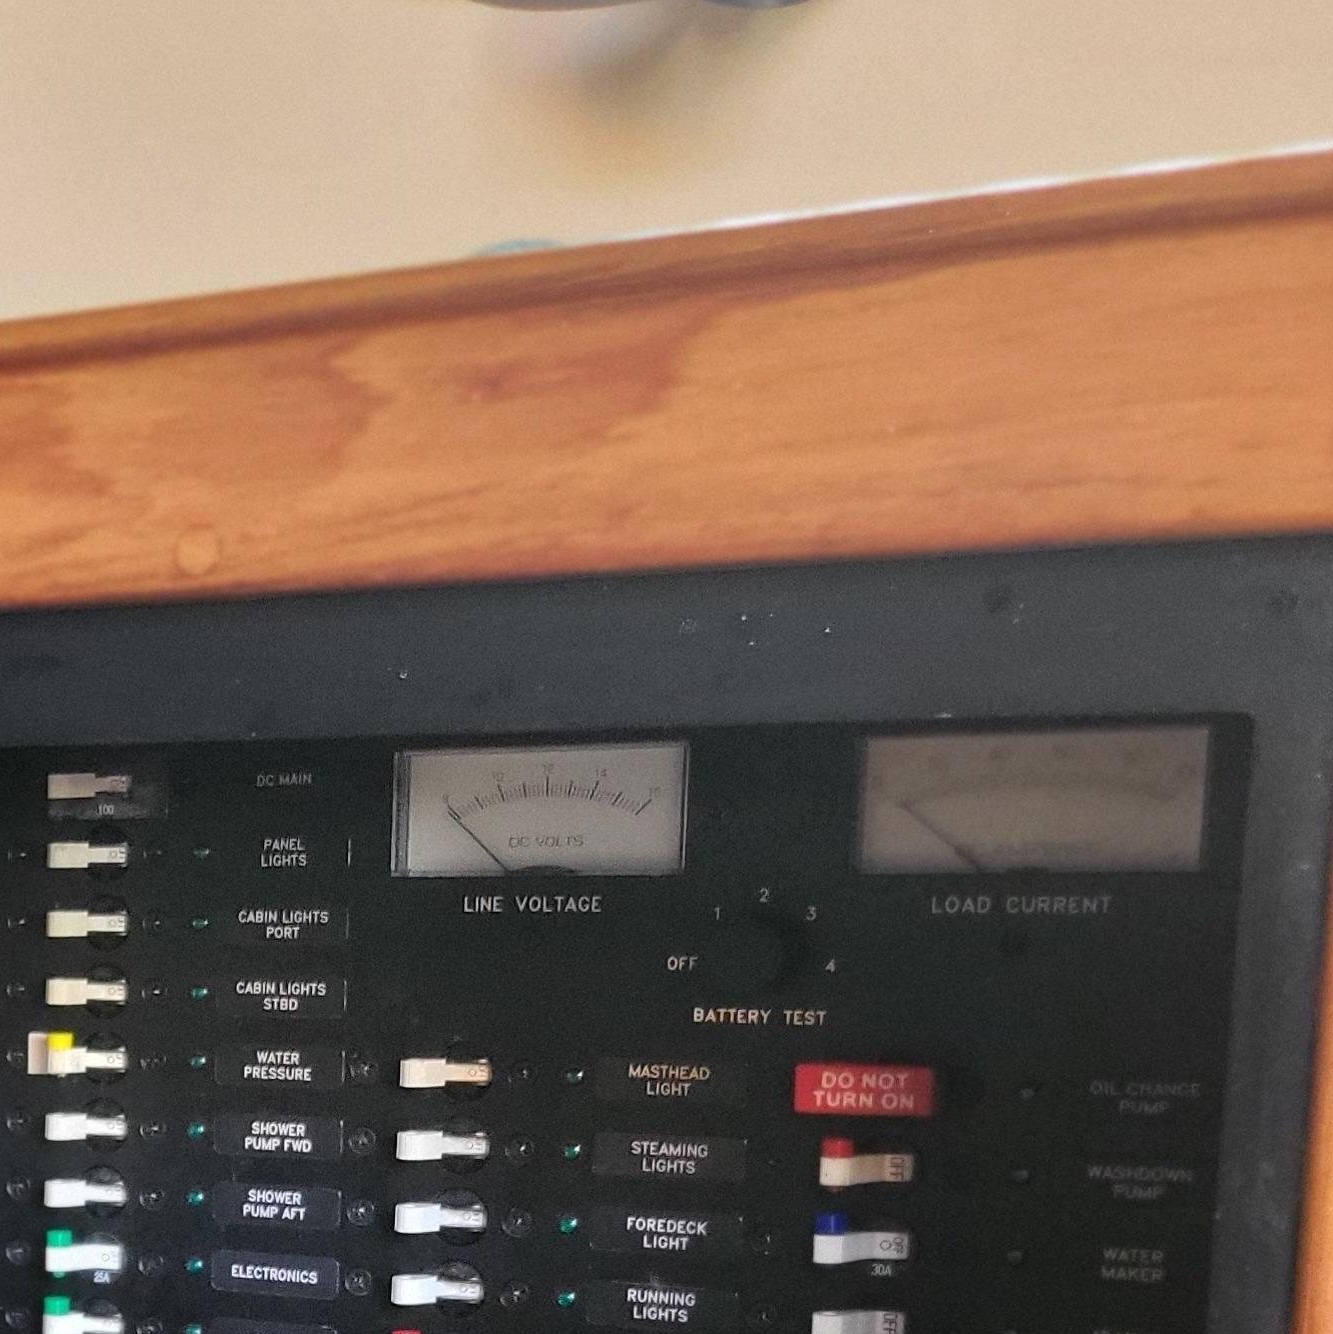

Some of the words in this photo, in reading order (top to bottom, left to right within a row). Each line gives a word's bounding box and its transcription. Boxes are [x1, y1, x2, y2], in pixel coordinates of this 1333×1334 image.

[257, 775, 277, 786] DC
[279, 773, 312, 785] MAIN
[263, 839, 304, 851] PANEL
[261, 853, 307, 867] LIGHTS
[759, 888, 769, 902] 2
[464, 897, 502, 912] LINE
[516, 897, 601, 912] VOLTAGE
[931, 897, 991, 914] LOAD
[1007, 897, 1112, 914] CURRENT
[238, 910, 278, 924] CABIN
[281, 911, 329, 924] LIGHTS
[714, 908, 721, 919] 1
[806, 907, 817, 921] 3
[267, 926, 299, 939] PORT
[667, 957, 698, 970] OFF
[825, 959, 835, 972] 4
[236, 982, 276, 996] CABIN
[279, 982, 326, 996] LIGHTS
[263, 998, 298, 1011] STBD
[694, 1008, 771, 1024] BATTERY
[783, 1011, 826, 1025] TEST
[256, 1052, 299, 1065] WATER
[244, 1066, 312, 1081] PRESSURE
[629, 1065, 710, 1081] MASTHEAD
[821, 1072, 854, 1089] DO
[862, 1072, 907, 1089] NOT
[646, 1082, 691, 1097] LIGHT
[1090, 1081, 1119, 1095] OIL
[814, 1091, 872, 1108] TURN
[882, 1092, 914, 1109] ON
[1119, 1101, 1170, 1114] PUMP
[252, 1122, 305, 1137] SHOWER
[245, 1137, 280, 1151] PUMP
[283, 1139, 312, 1153] FWD
[631, 1142, 708, 1158] STEAMING
[642, 1159, 695, 1175] LIGHTS
[1087, 1165, 1193, 1181] WASHDOWN
[248, 1190, 301, 1205] SHOWER
[1113, 1185, 1164, 1199] PUMP
[243, 1205, 278, 1219] PUMP
[281, 1207, 305, 1221] AFT
[627, 1217, 707, 1235] FOREDECK
[643, 1235, 689, 1250] LIGHT
[1103, 1249, 1164, 1263] WATER
[94, 1271, 110, 1283] 25A
[231, 1265, 317, 1285] ELECTRONICS
[871, 1264, 892, 1276] 30A
[1101, 1267, 1164, 1281] MAKER
[627, 1289, 695, 1307] RUNNING
[633, 1306, 688, 1323] LIGHTS
[884, 1313, 897, 1334] OFF
